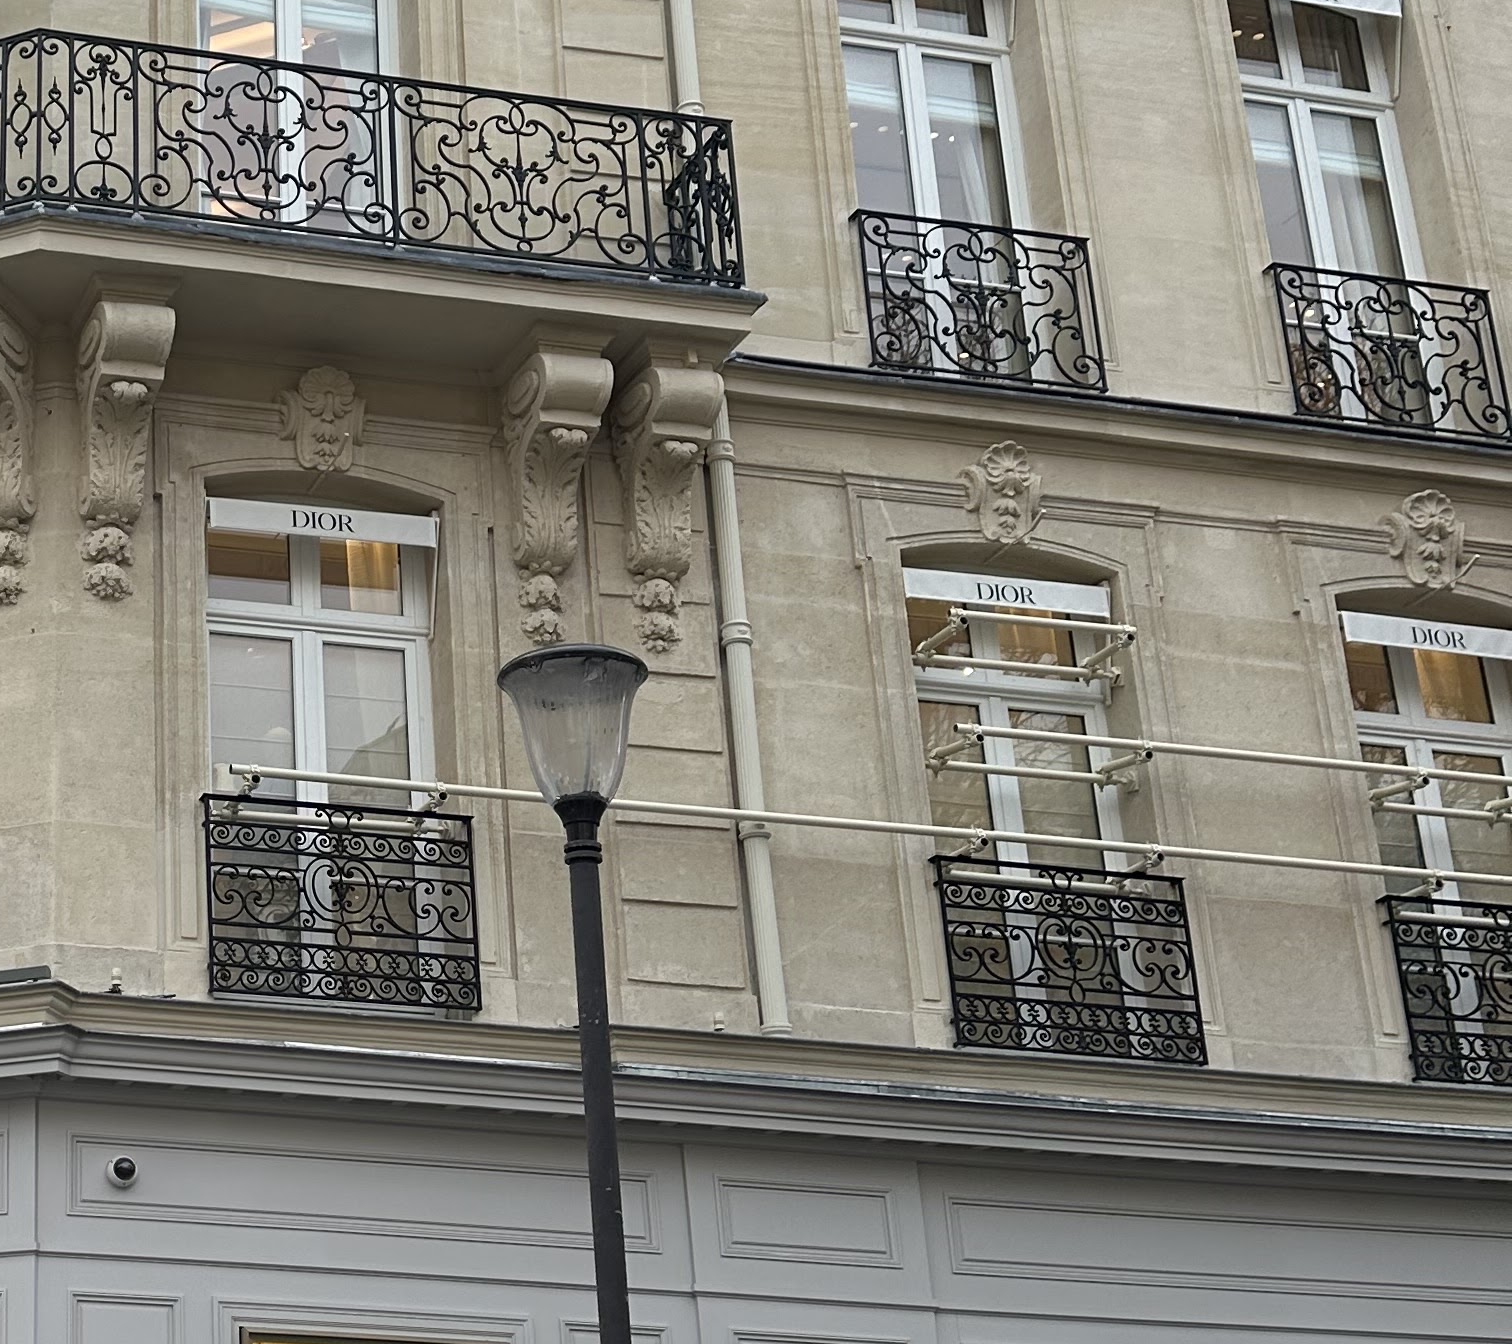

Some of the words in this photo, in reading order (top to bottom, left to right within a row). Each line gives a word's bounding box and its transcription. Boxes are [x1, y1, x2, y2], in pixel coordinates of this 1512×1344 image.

[291, 509, 356, 534] DIOR
[974, 582, 1037, 607] DIOR
[1411, 626, 1468, 650] DIOR
